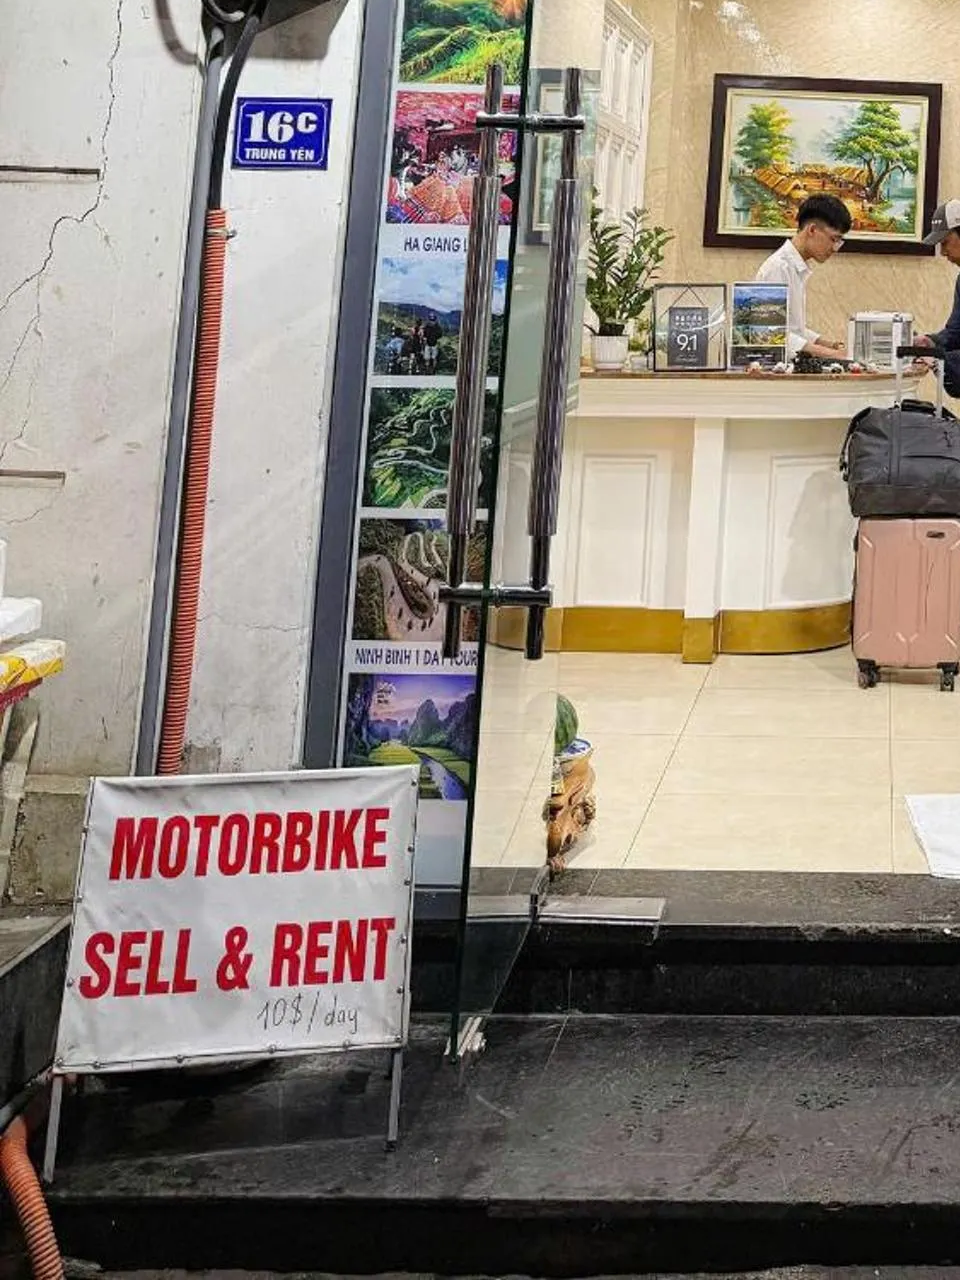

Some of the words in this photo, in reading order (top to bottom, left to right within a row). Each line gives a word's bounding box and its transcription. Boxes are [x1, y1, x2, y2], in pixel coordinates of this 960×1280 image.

[244, 148, 285, 161] TRUNG
[290, 145, 315, 162] YÊN
[404, 237, 421, 251] HA
[423, 237, 461, 252] GIANG
[355, 648, 383, 665] NINH
[385, 649, 412, 666] BINH
[108, 807, 391, 881] MOTORBIKE
[78, 928, 198, 1000] SELL
[215, 925, 255, 992] &
[269, 917, 396, 988] RENT
